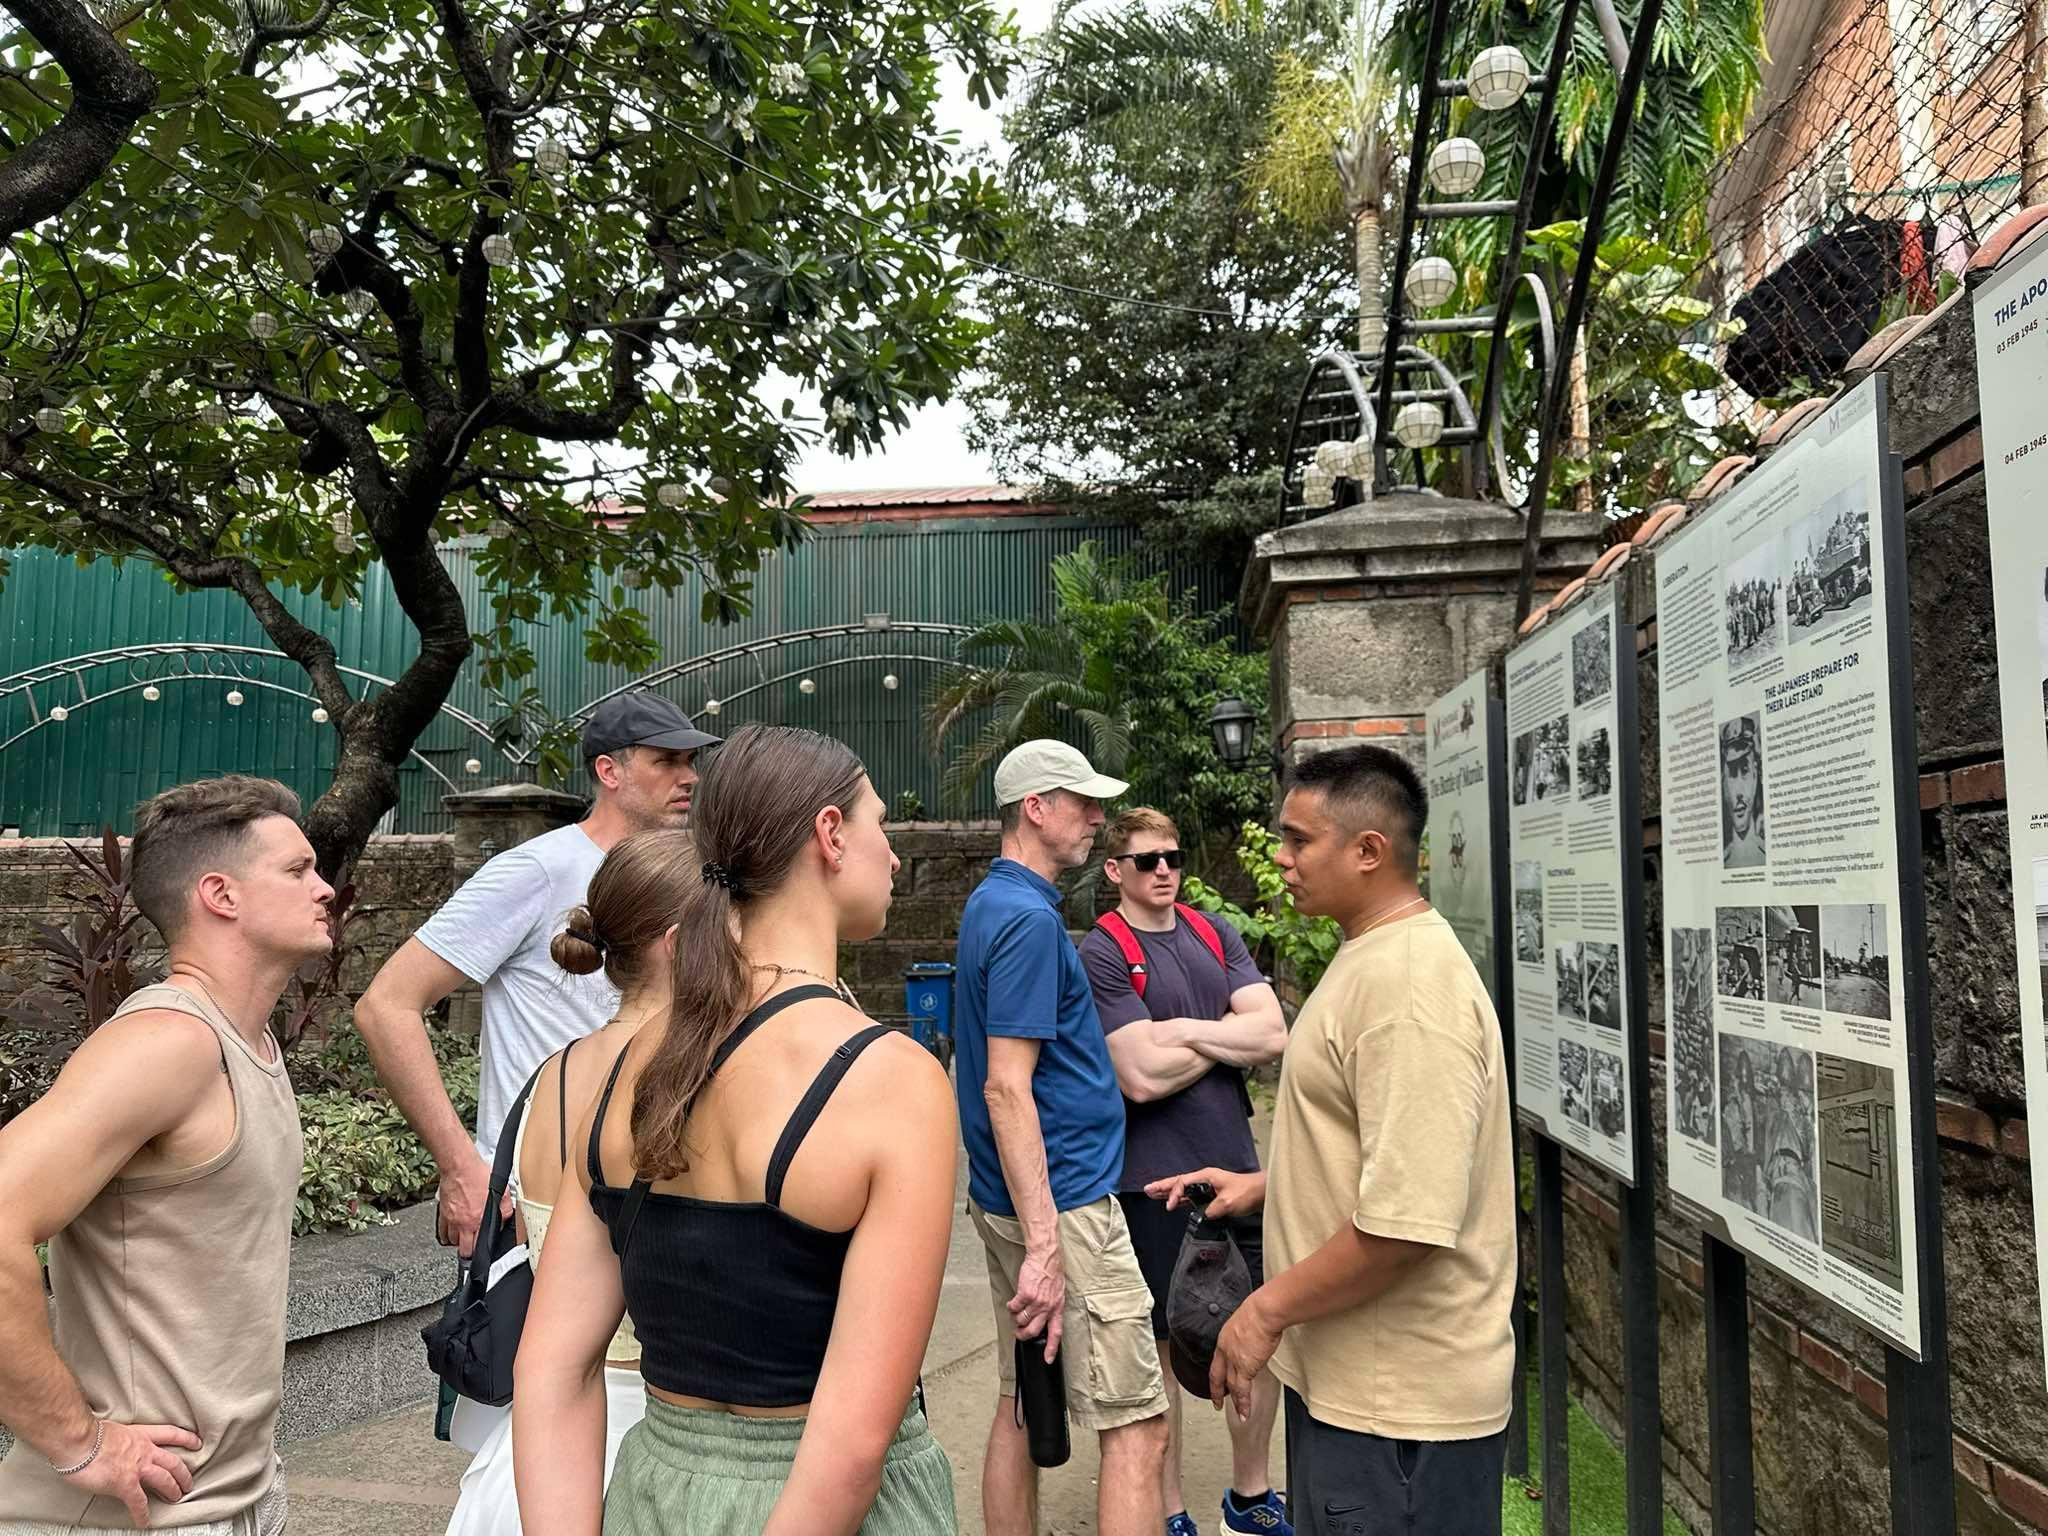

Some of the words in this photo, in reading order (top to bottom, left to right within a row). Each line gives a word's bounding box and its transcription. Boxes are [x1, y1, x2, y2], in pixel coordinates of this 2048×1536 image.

[1994, 299, 2017, 327] THE
[2020, 278, 2048, 310] APO
[1996, 340, 2006, 355] 03
[2007, 332, 2020, 348] FEB
[2021, 319, 2038, 338] 1945
[2004, 452, 2014, 465] 04
[2015, 445, 2029, 460] FEB
[2029, 434, 2047, 452] 1945
[1765, 685, 1777, 700] THE
[1777, 672, 1810, 695] JAPANESE
[1811, 659, 1843, 683] PREPARE
[1843, 652, 1860, 669] FOR
[1765, 699, 1784, 715] THEIR
[1785, 692, 1801, 708] LAST
[1801, 683, 1824, 702] STAND
